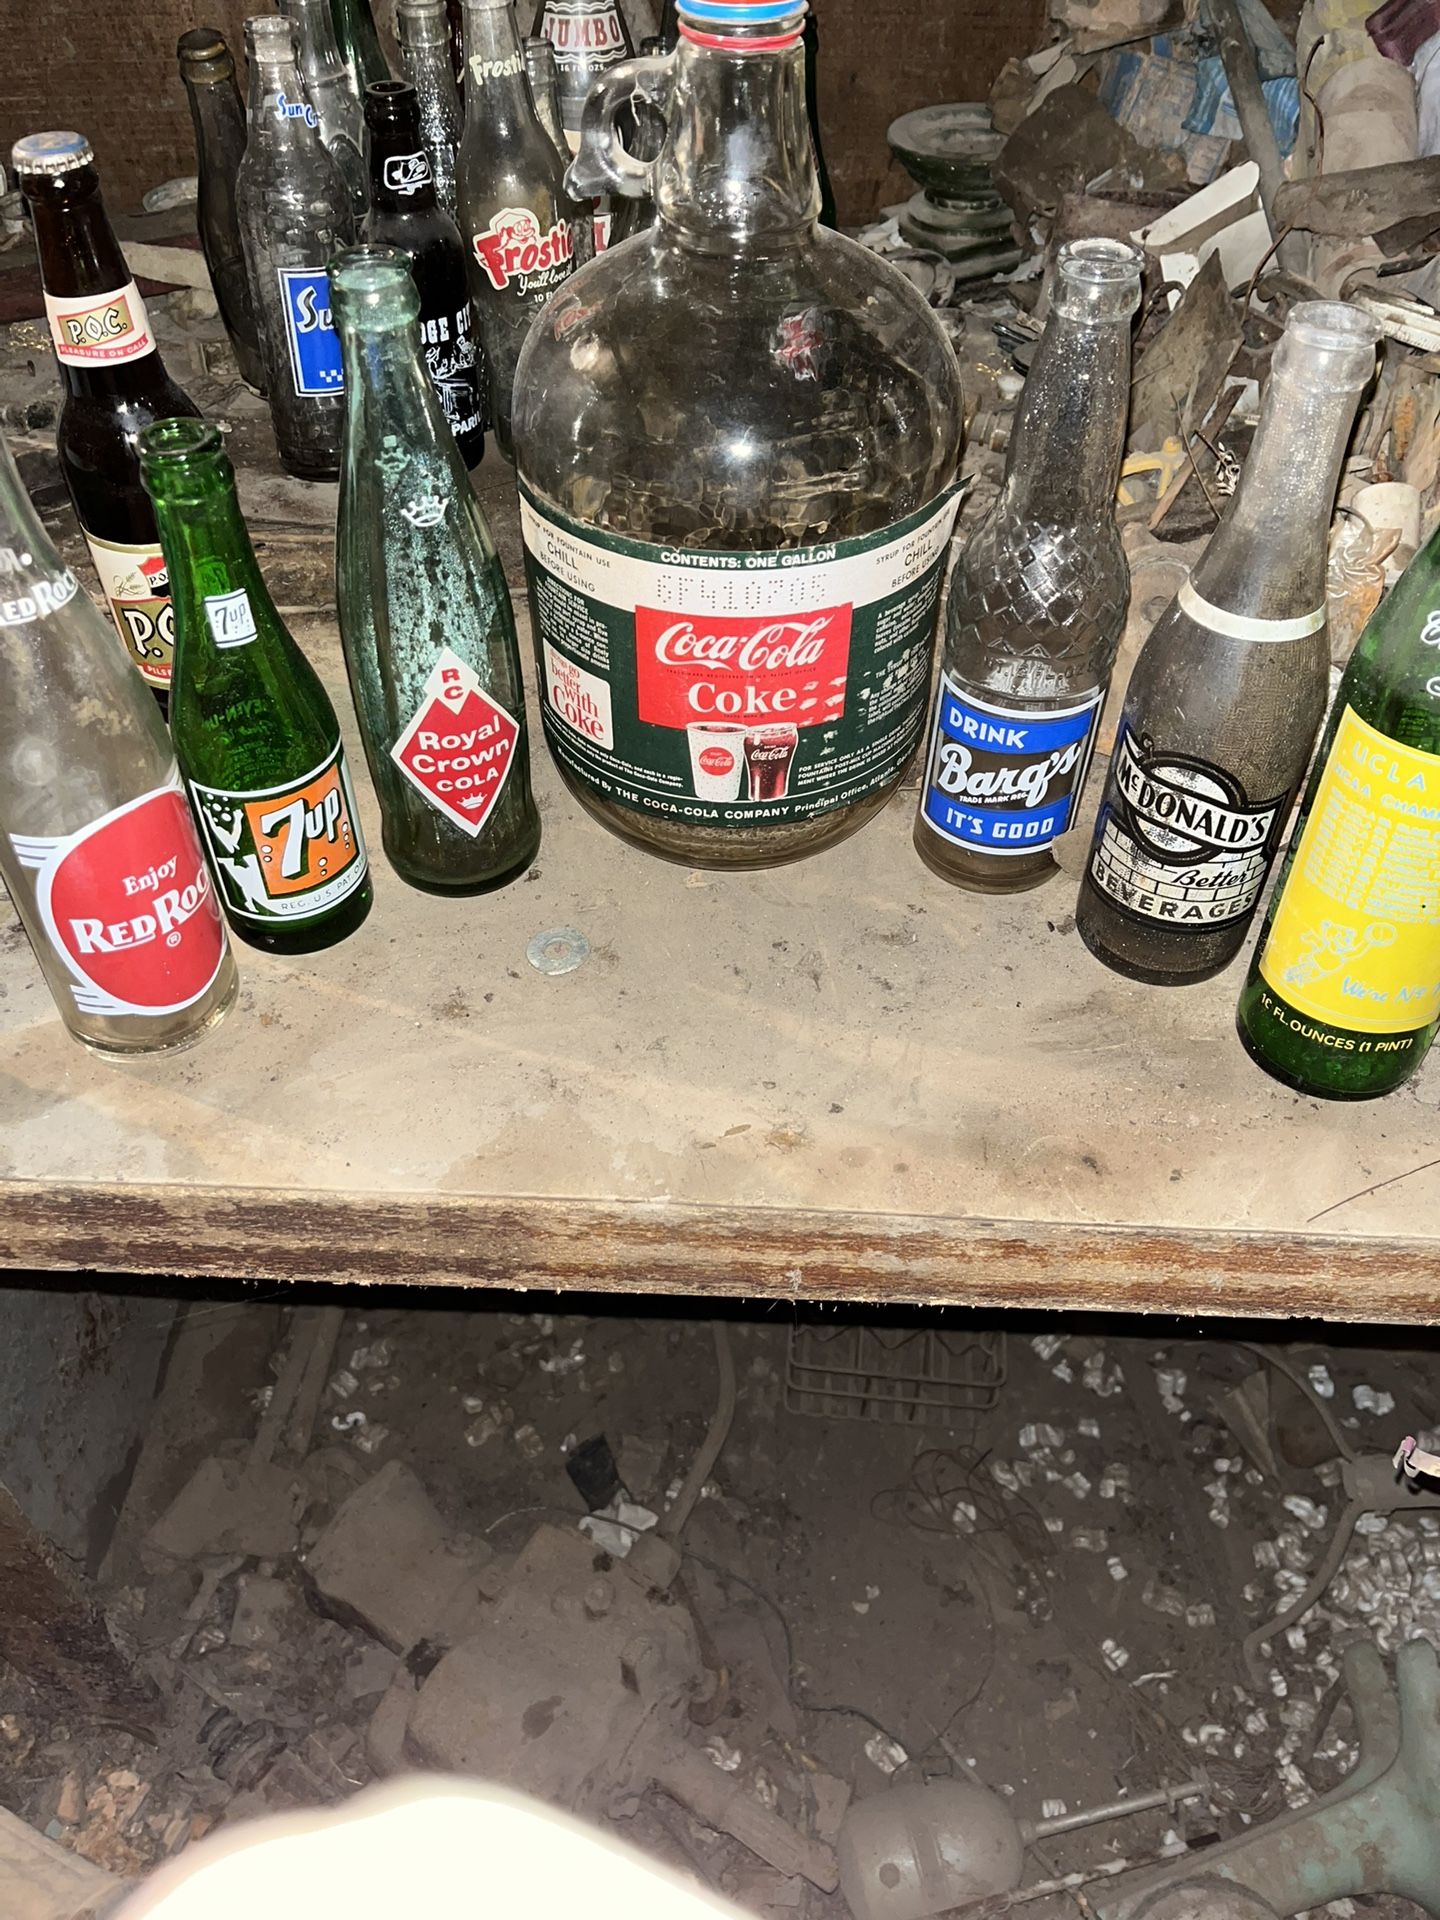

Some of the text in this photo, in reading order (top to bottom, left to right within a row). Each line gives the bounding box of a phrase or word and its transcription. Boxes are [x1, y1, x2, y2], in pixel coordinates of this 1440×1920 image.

[545, 14, 620, 48] JUMBO
[296, 285, 335, 333] Su
[534, 294, 544, 303] 10
[66, 307, 128, 345] P.O.C.
[547, 541, 579, 570] CHILL
[596, 557, 611, 568] USE
[661, 548, 836, 569] CONTENTS: ONE GALLON
[876, 549, 899, 565] SYRUP
[902, 540, 915, 553] FOR
[904, 540, 932, 566] CHILL
[540, 551, 596, 592] BEFORE USING
[891, 566, 920, 588] BEFORE
[655, 615, 835, 671] Coca-Cola
[553, 685, 604, 741] Coke
[564, 684, 599, 719] with
[688, 682, 797, 714] Coke
[417, 714, 502, 751] Royal
[949, 707, 1029, 749] DRINK
[411, 738, 510, 774] Crown
[699, 755, 734, 767] Coca-Cola
[750, 746, 790, 761] Coca-Cola
[798, 764, 812, 773] FOR
[814, 758, 837, 769] SERVICE
[839, 752, 855, 761] ONLY
[1352, 741, 1426, 792] UCLA
[436, 767, 499, 792] COLA
[938, 742, 1081, 808] Barq's
[615, 786, 639, 802] THE
[643, 797, 719, 818] COCA-COLA
[724, 806, 790, 820] COMPANY
[794, 795, 839, 813] Principal
[840, 784, 869, 800] Office,
[959, 795, 983, 804] TRADE
[984, 795, 1010, 804] MARK
[946, 807, 1055, 840] IT'S GOOD
[122, 855, 177, 896] Enjoy
[1095, 861, 1252, 920] BEVERAGES
[1171, 868, 1249, 888] Better
[1290, 1019, 1356, 1050] OUNCES
[1374, 1038, 1413, 1052] PINT)
